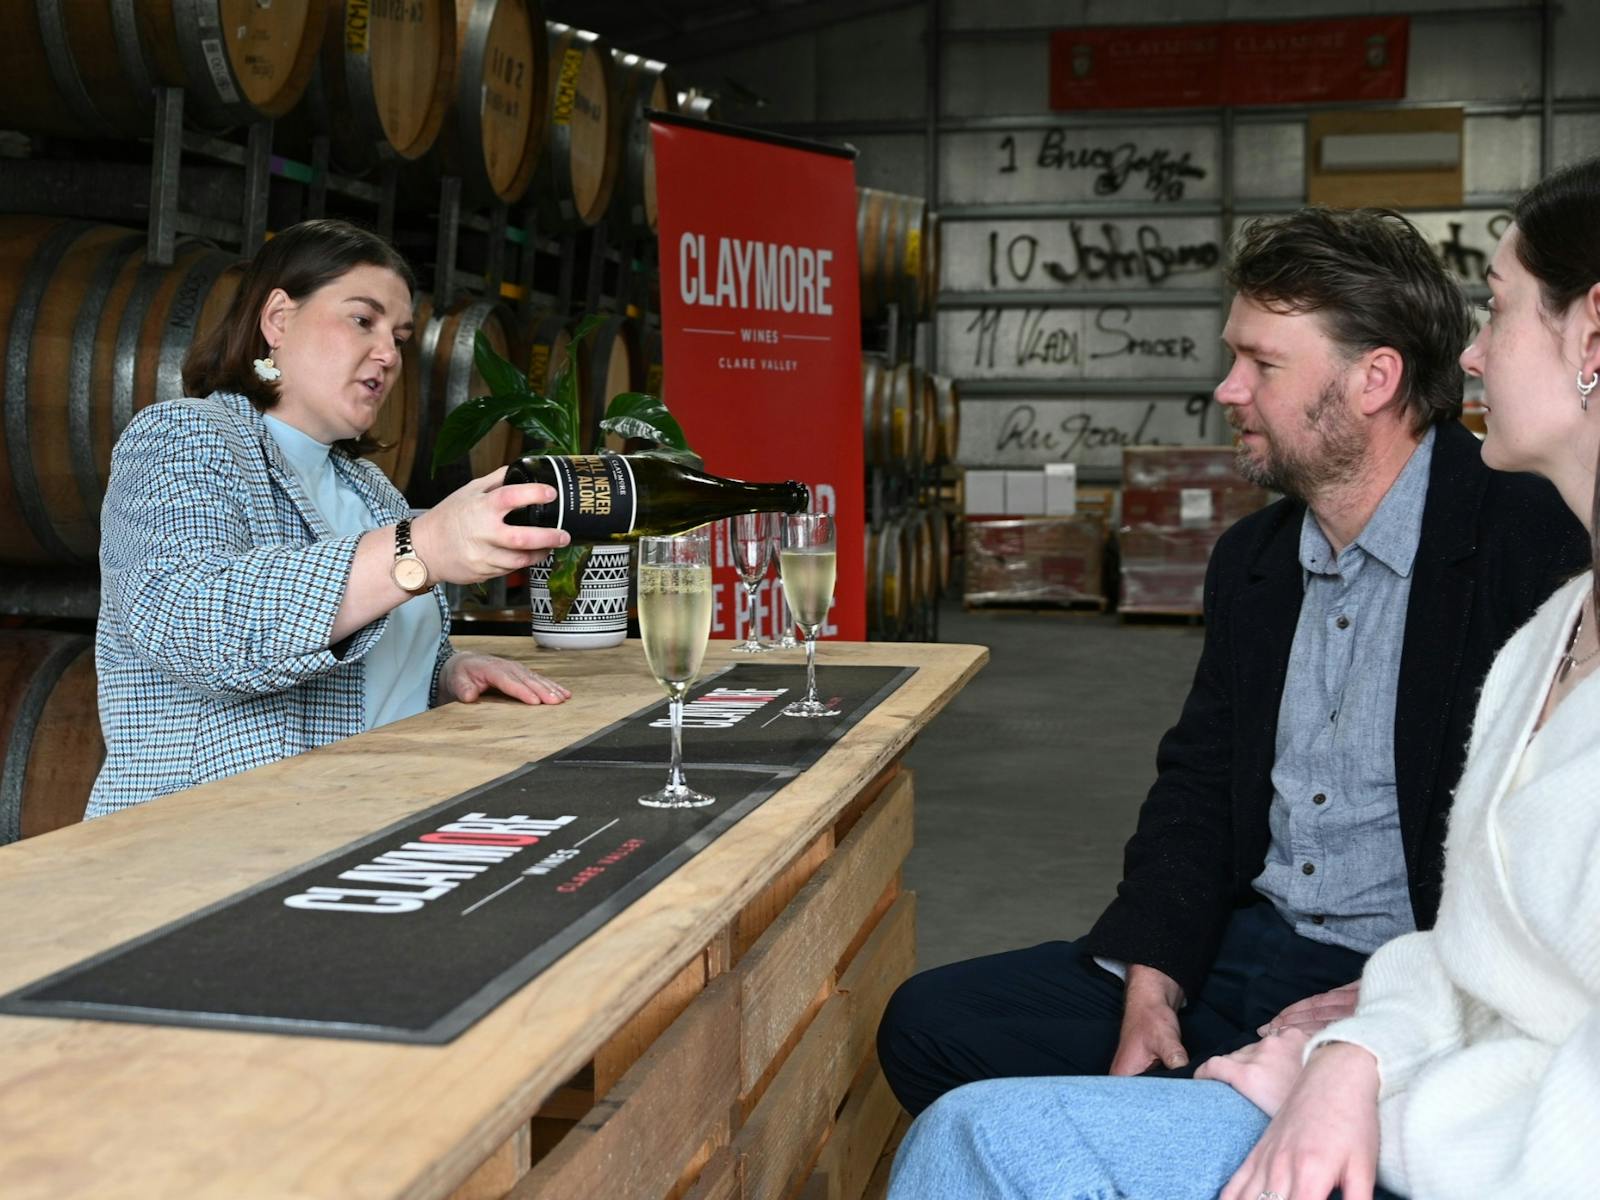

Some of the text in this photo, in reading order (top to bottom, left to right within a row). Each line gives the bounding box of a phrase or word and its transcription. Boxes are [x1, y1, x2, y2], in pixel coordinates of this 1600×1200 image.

[1108, 36, 1217, 57] CLAYMRE
[1234, 31, 1346, 52] CLAYMRE
[999, 135, 1018, 173] 1
[680, 232, 833, 315] CLAYMORE
[989, 231, 1039, 287] 10
[740, 328, 779, 344] WINES
[719, 357, 797, 371] CLARE VALLEY
[1185, 392, 1214, 439] 9
[576, 476, 594, 515] ALONE
[594, 477, 611, 516] NEVER
[612, 459, 627, 496] CLAYMORE
[735, 577, 838, 641] PEOE
[283, 813, 578, 913] CLAYMORE
[521, 848, 581, 875] WINES
